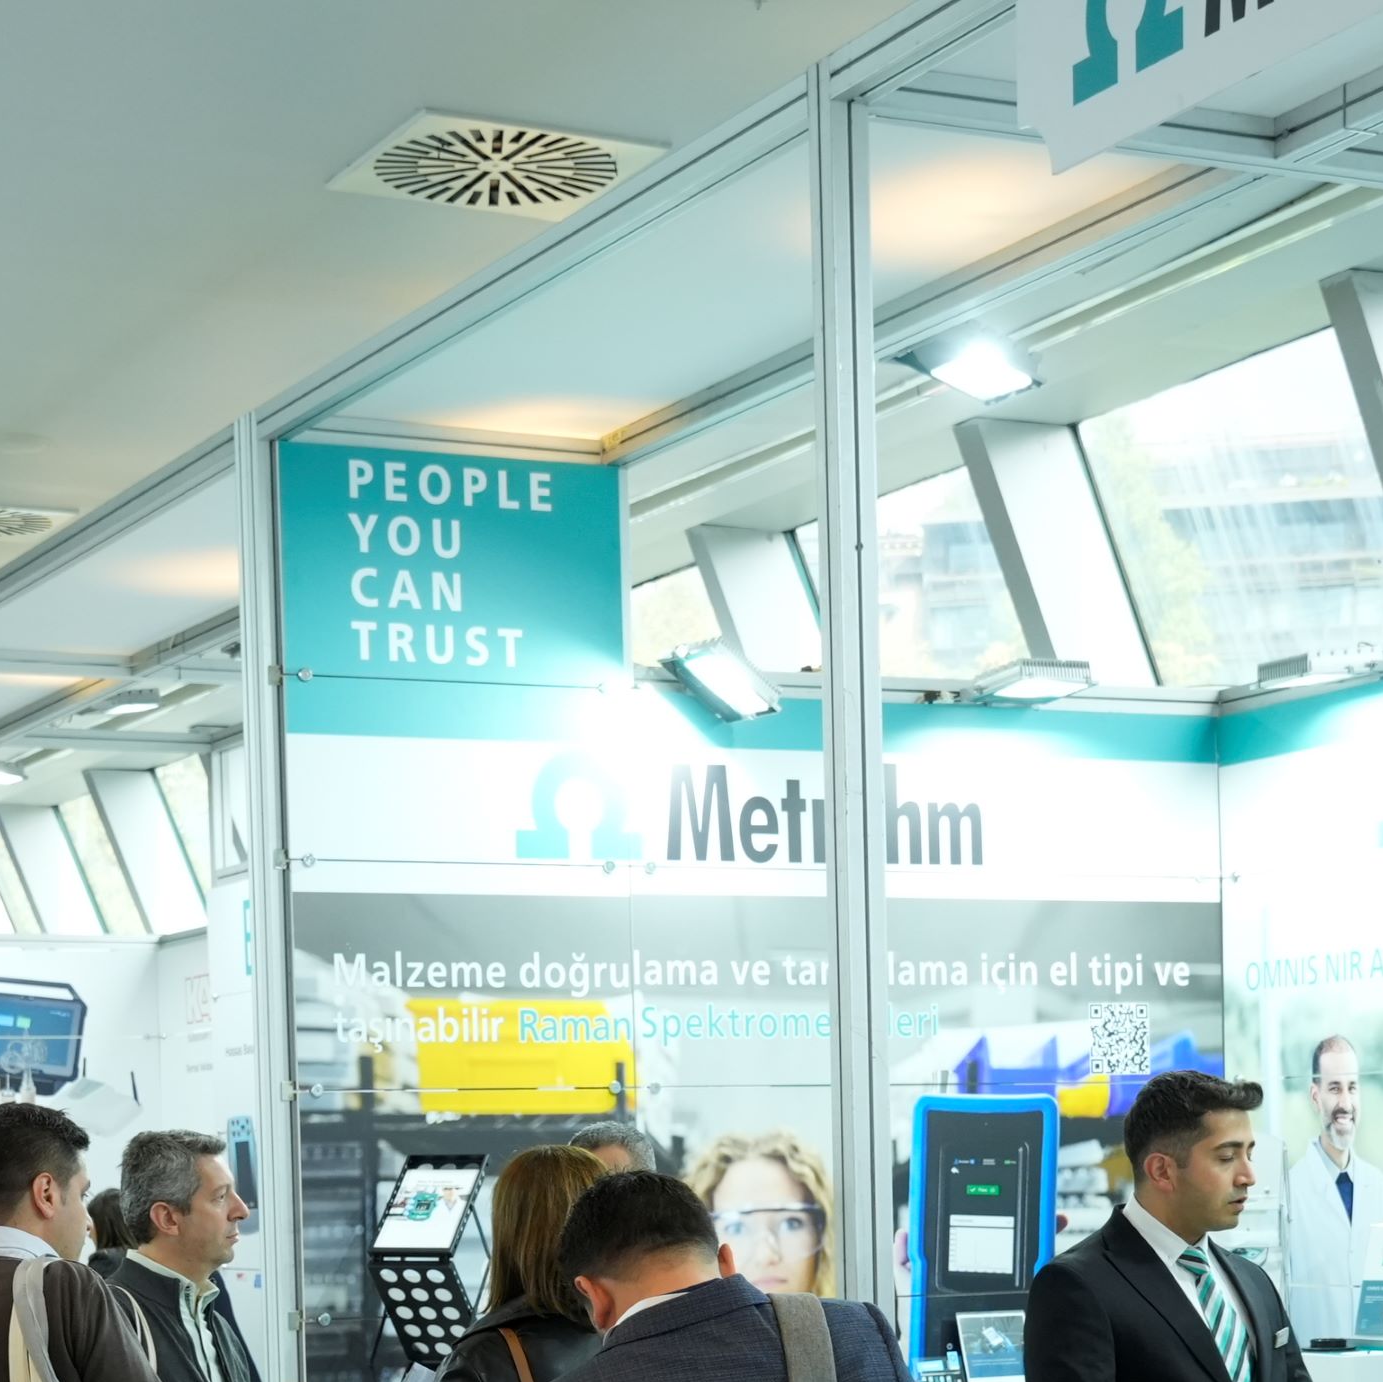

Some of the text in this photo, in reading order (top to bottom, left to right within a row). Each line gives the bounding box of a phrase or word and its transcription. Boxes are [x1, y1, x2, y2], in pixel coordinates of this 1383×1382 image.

[347, 459, 553, 513] PEOPLE
[347, 513, 462, 560] YOU
[350, 567, 463, 613] CAN
[350, 620, 523, 668] TRUST
[666, 764, 984, 866] Metrhm
[332, 950, 507, 989] Malzeme
[518, 949, 719, 998] doğrulama
[730, 959, 771, 987] ve
[980, 952, 1039, 995] için
[1049, 951, 1079, 987] el
[1088, 953, 1143, 995] tipi
[1154, 959, 1191, 987] ve
[1245, 954, 1318, 992] OMNIS
[1325, 951, 1363, 983] NIR
[332, 1004, 504, 1054] taşınabilir
[518, 1009, 632, 1043] Raman
